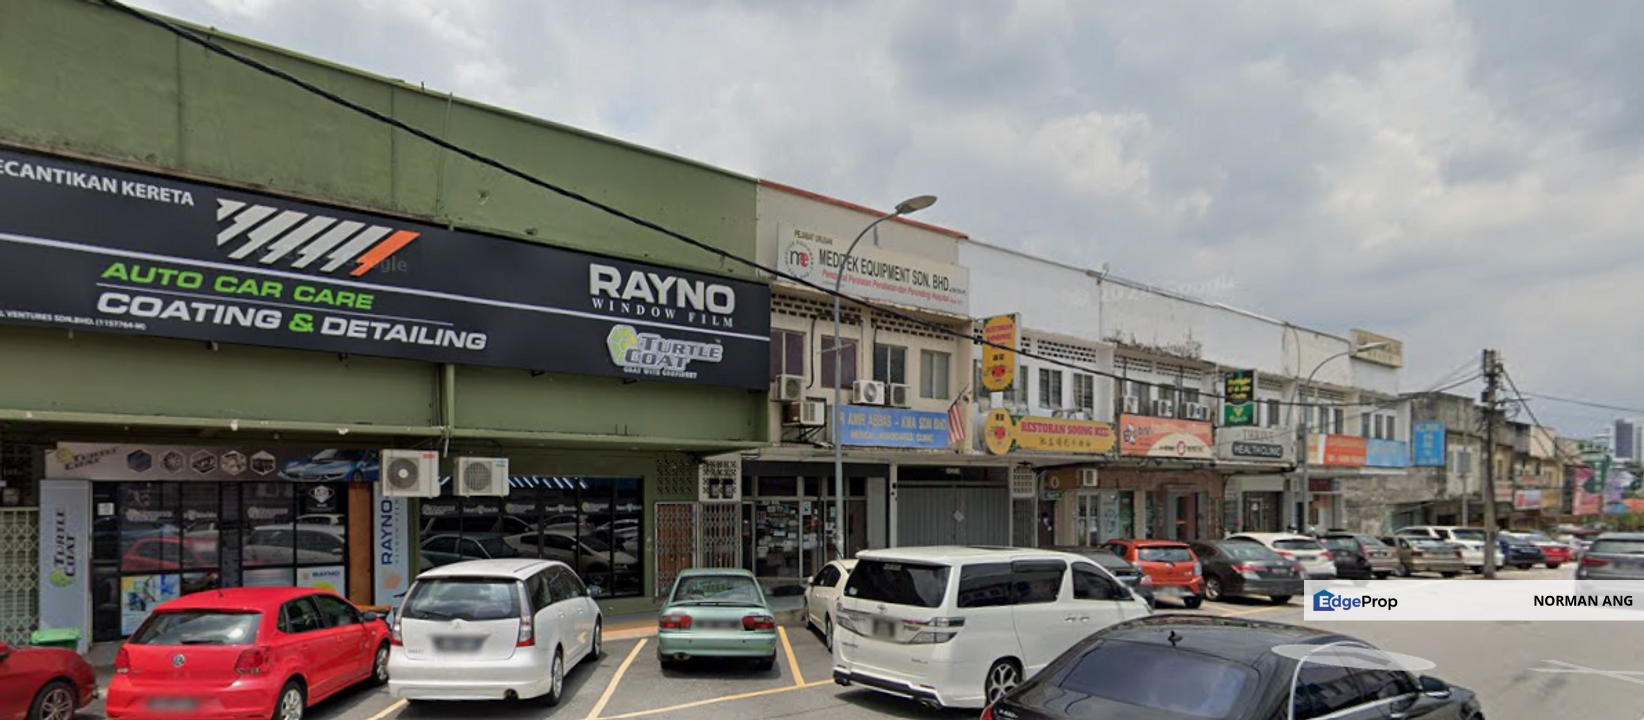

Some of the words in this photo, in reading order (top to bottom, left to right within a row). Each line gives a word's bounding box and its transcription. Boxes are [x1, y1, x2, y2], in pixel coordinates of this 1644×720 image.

[122, 180, 195, 206] KERETA
[861, 258, 911, 284] EQUIPMENT
[101, 262, 203, 290] AUTO
[214, 275, 283, 299] CAR
[293, 285, 375, 310] CARE
[589, 263, 735, 315] RAYNO
[97, 292, 282, 328] COATING
[289, 313, 314, 333] &
[320, 316, 488, 350] DETAILING
[592, 297, 676, 319] WINDOW
[688, 311, 734, 328] FILM
[623, 348, 689, 369] COAT
[640, 336, 721, 360] TURTLE
[623, 366, 641, 374] COAT
[869, 414, 892, 428] ABBAS
[1020, 421, 1066, 435] RESTORAN
[1067, 424, 1093, 436] SOONG
[1094, 426, 1110, 437] KEE
[54, 507, 65, 567] TURTLE
[380, 499, 393, 566] RAYNO
[65, 534, 75, 577] COAT
